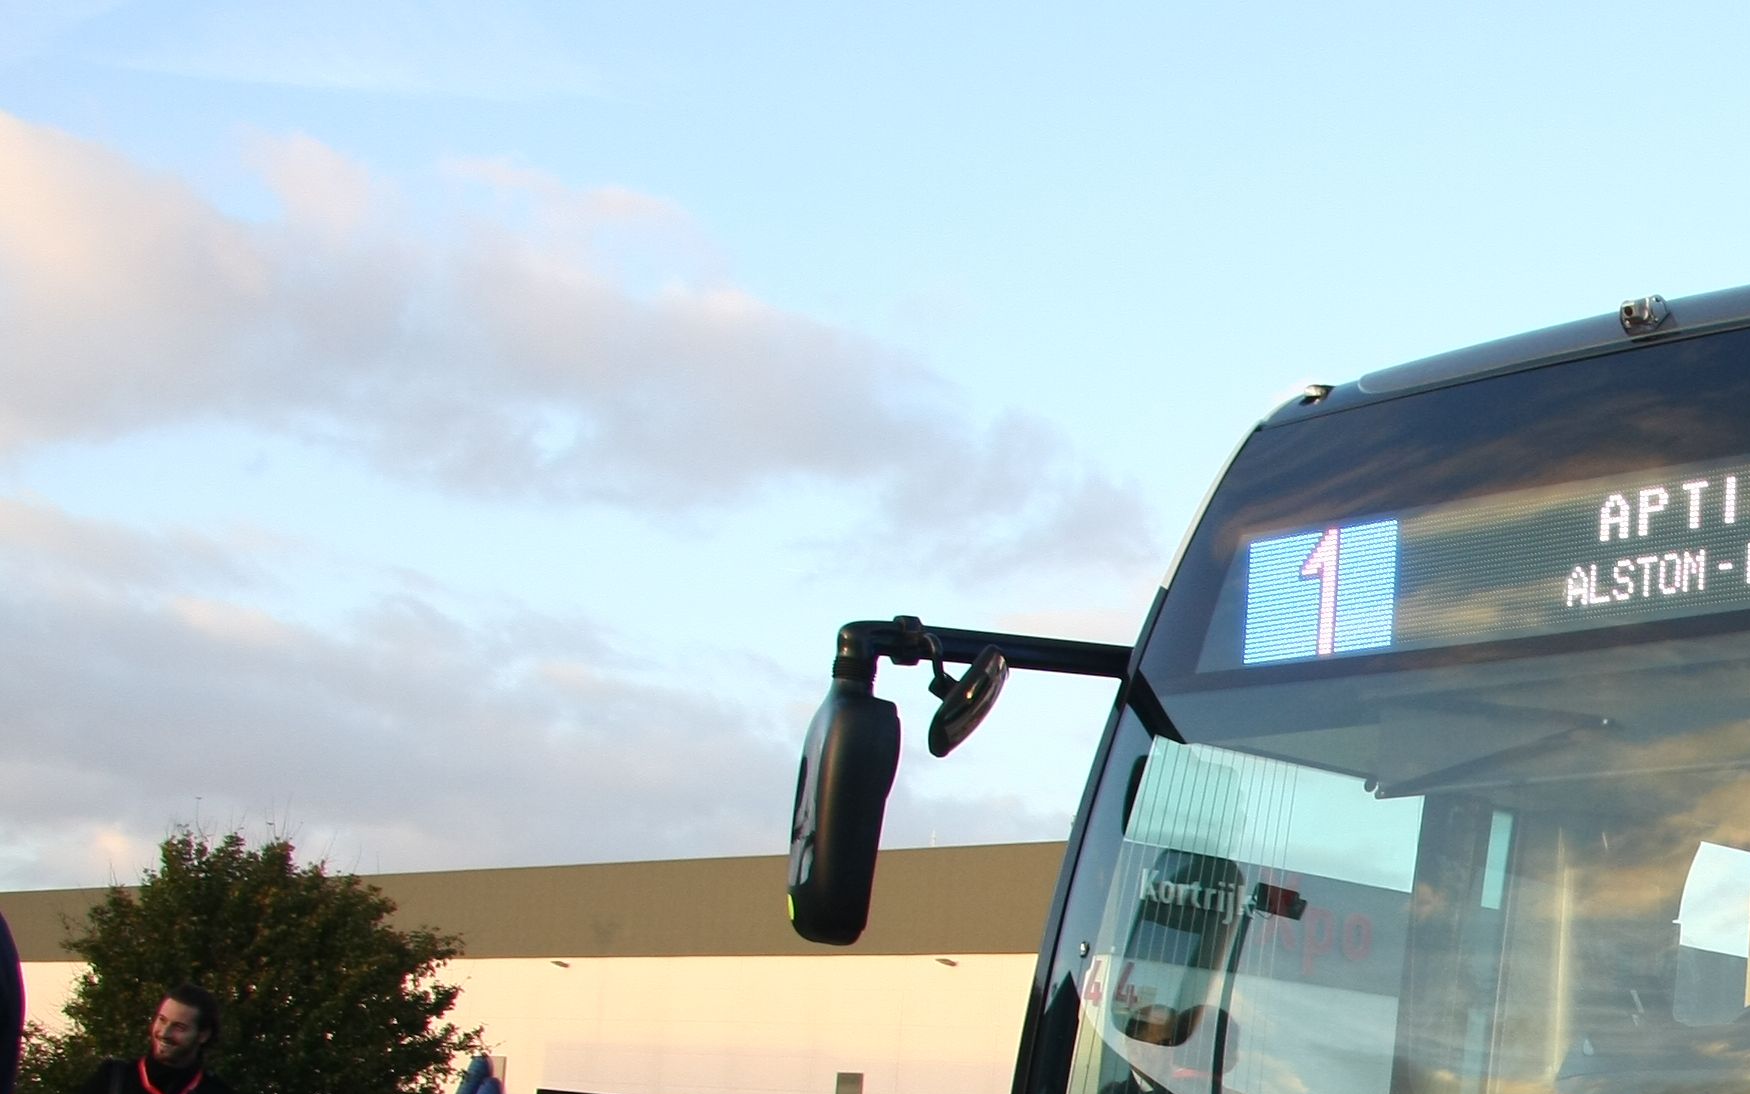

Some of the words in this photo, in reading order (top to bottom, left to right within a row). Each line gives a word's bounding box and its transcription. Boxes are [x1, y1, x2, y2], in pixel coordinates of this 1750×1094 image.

[1300, 528, 1340, 656] 1
[1565, 549, 1706, 609] ALSTOM
[1139, 868, 1255, 924] Kortrijk
